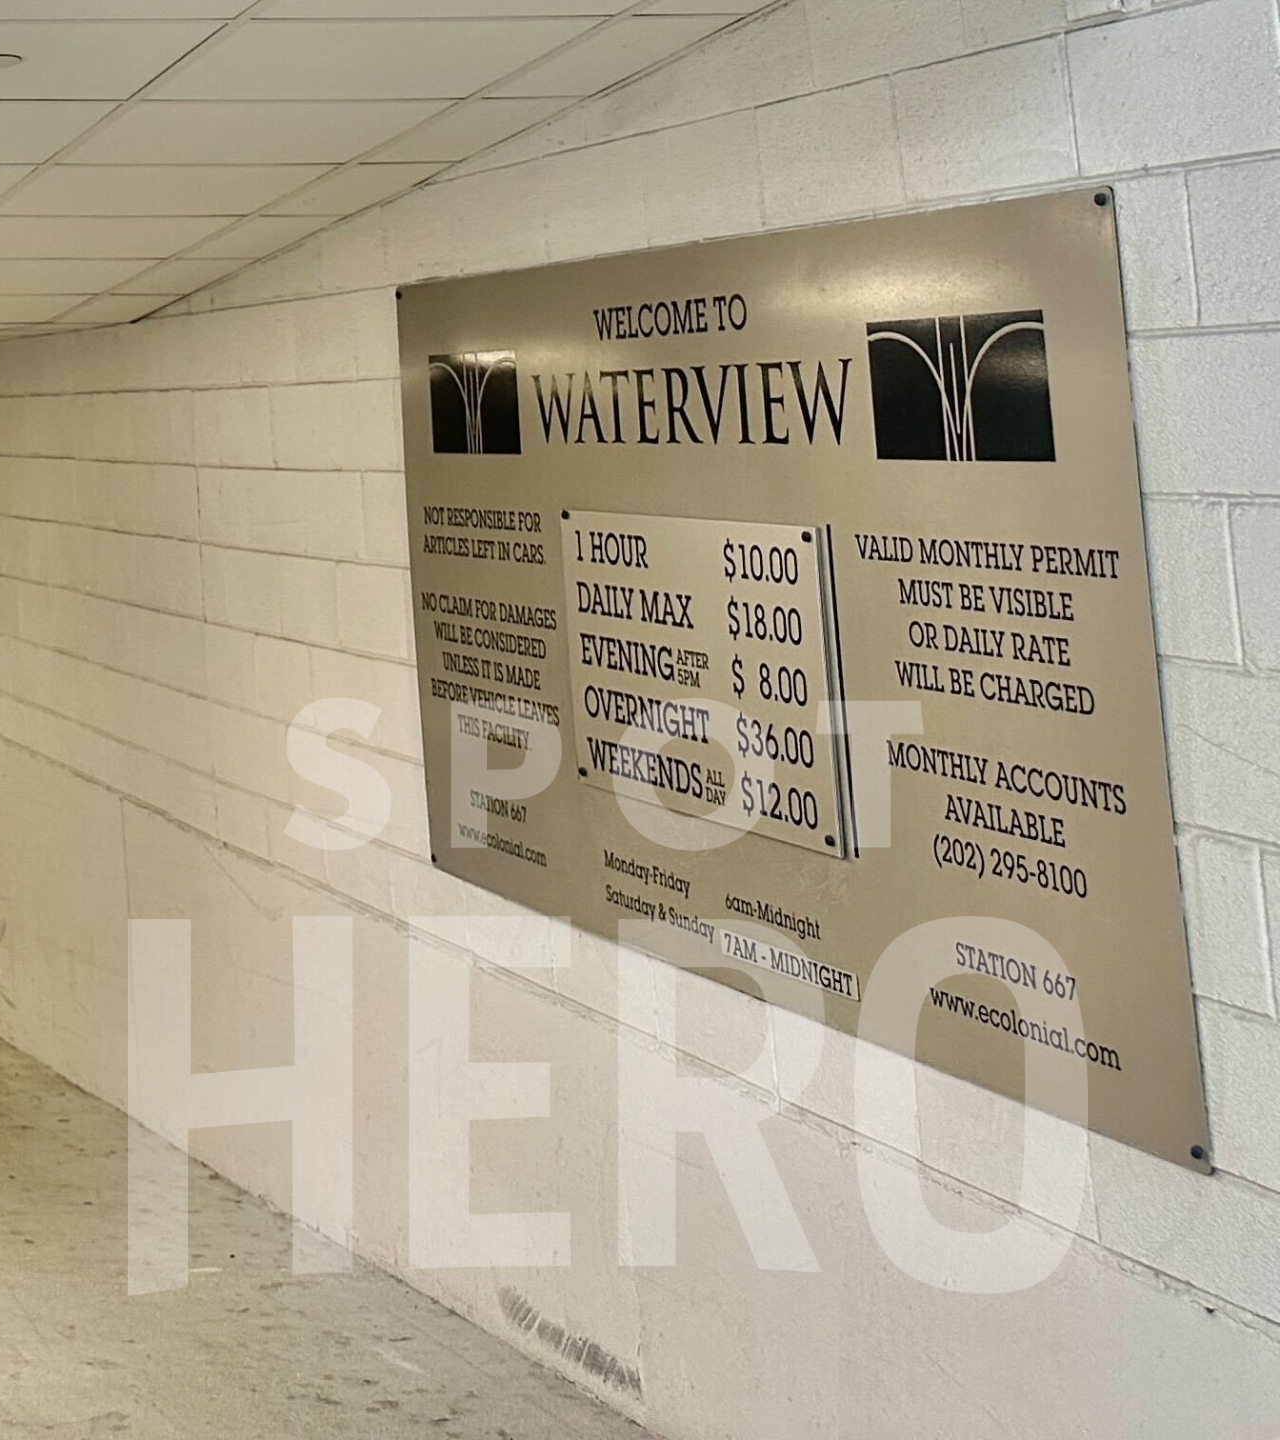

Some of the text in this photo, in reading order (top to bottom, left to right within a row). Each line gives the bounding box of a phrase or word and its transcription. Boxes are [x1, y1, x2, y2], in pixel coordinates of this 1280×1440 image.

[593, 293, 747, 341] WELCOME TO
[531, 358, 853, 445] WATERVIEW
[423, 506, 541, 533] NOT RESPONSIBLE FOR
[423, 534, 469, 557] ARTICLES
[471, 539, 496, 560] LEFT
[498, 541, 510, 561] IN
[575, 530, 799, 586] 1 HOUR $10.00
[854, 534, 1119, 579] VALID MONTHLY PERMIT
[421, 591, 557, 631] NO CLAIM FOR DAMAGES
[576, 581, 802, 646] DAILY MAX $18.00
[897, 578, 1075, 622] MUST BE VISIBLE
[433, 621, 546, 659] WILL BE CONSIDERED
[579, 633, 709, 682] EVENING AFTER
[908, 620, 1071, 667] OR DAILY RATE
[442, 651, 541, 691] UNLESS IT IS MADE
[677, 669, 701, 689] 5PM
[895, 660, 1095, 716] WILL BE CHARGED
[430, 677, 560, 727] BEFORE VEHICLE LEAVES
[457, 713, 480, 738] THIS
[584, 685, 815, 769] OVERNIGHT $36.00
[586, 736, 818, 830] WEEKENDS ALL $12.00
[706, 786, 727, 807] DAY
[886, 740, 1127, 815] MONTHLY ACCOUNTS
[470, 789, 527, 823] STATION 667
[944, 794, 1066, 848] AVAILABLE
[933, 833, 1088, 898] (202) 295-8100
[603, 849, 822, 941] Monday-Friday 6am-Midnight
[605, 884, 656, 922] Saturday
[658, 903, 667, 921] &
[669, 907, 716, 944] Sunday
[723, 933, 758, 964] 7AM
[769, 947, 853, 997] MIDNIGHT
[955, 942, 1076, 1001] STATION 667
[929, 987, 1122, 1071] www.ecolonial.com
